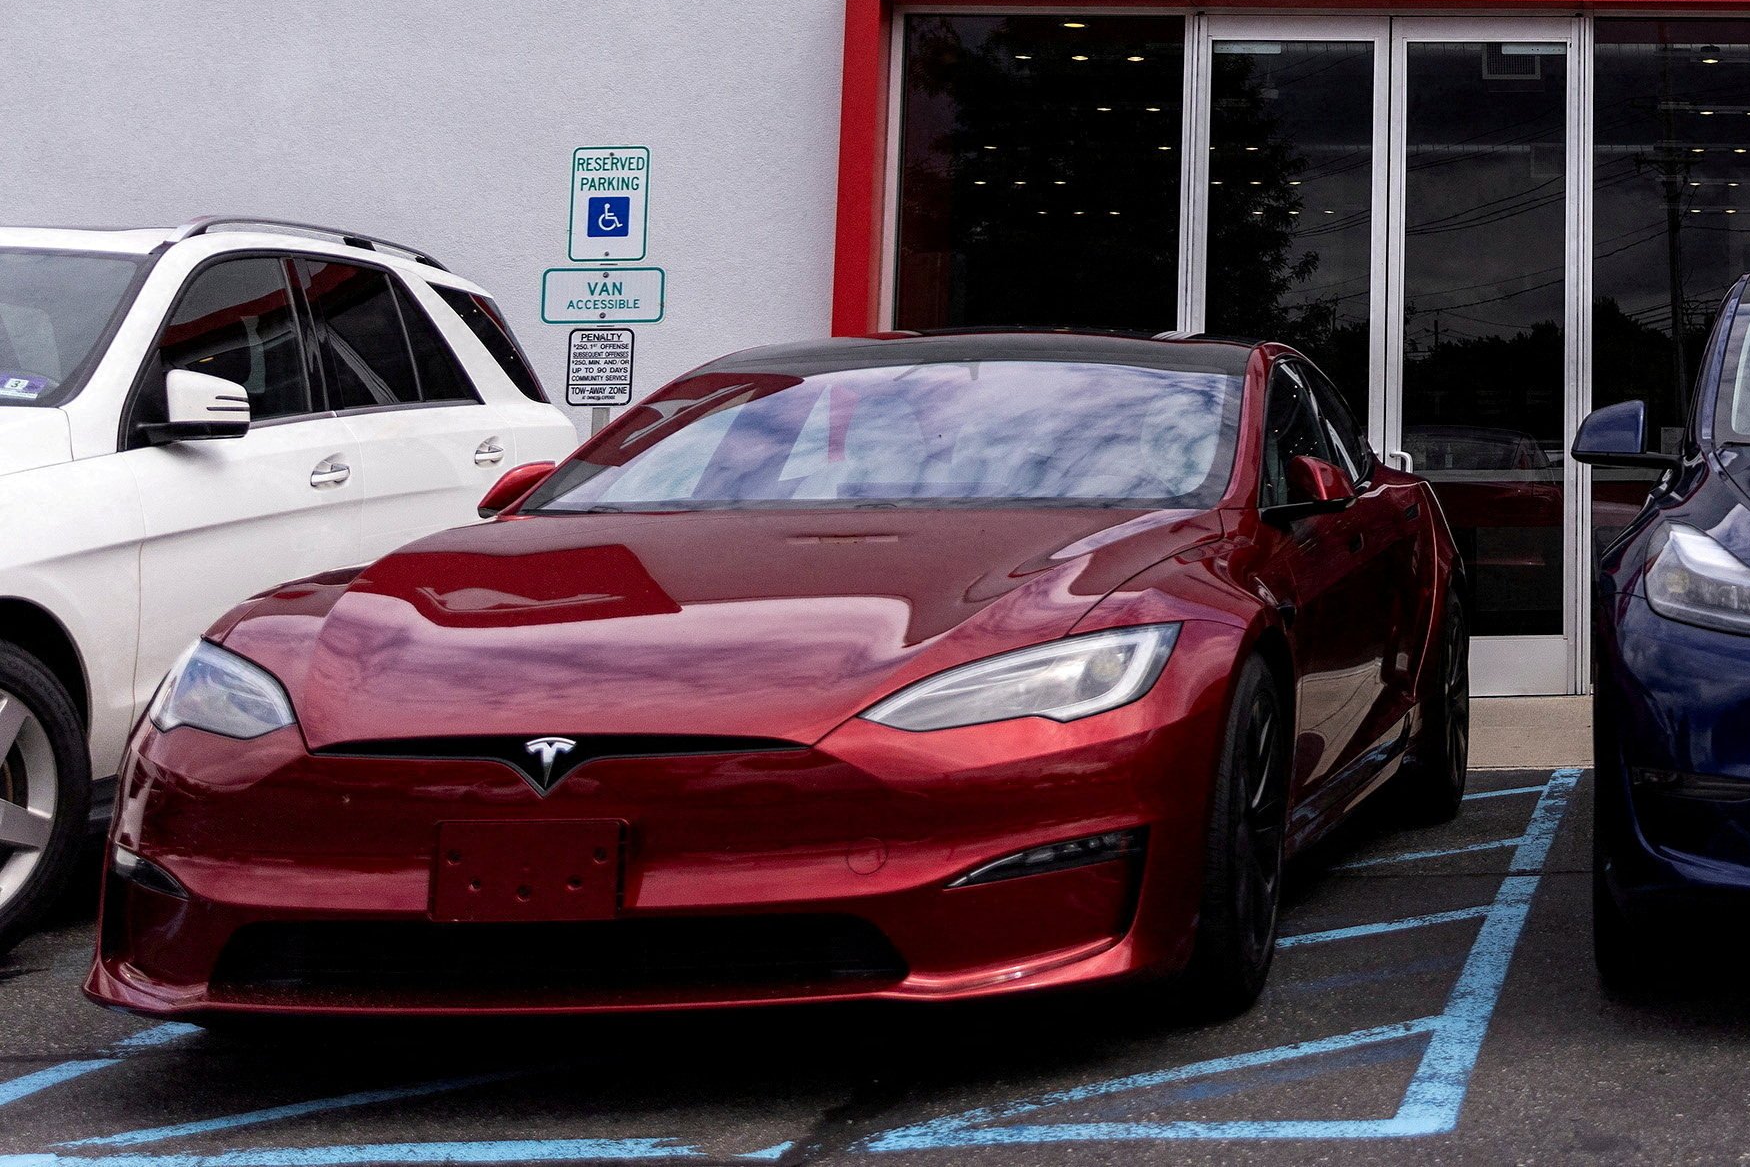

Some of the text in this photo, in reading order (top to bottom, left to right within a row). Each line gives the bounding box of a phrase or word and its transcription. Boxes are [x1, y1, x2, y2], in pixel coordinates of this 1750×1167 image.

[576, 156, 645, 172] RESERVED
[580, 176, 640, 192] PARKING
[587, 282, 623, 296] VAN
[567, 299, 640, 310] ACCESSIBLE
[581, 333, 623, 341] PENALTY
[571, 386, 627, 395] TOW-AWAY ZONE
